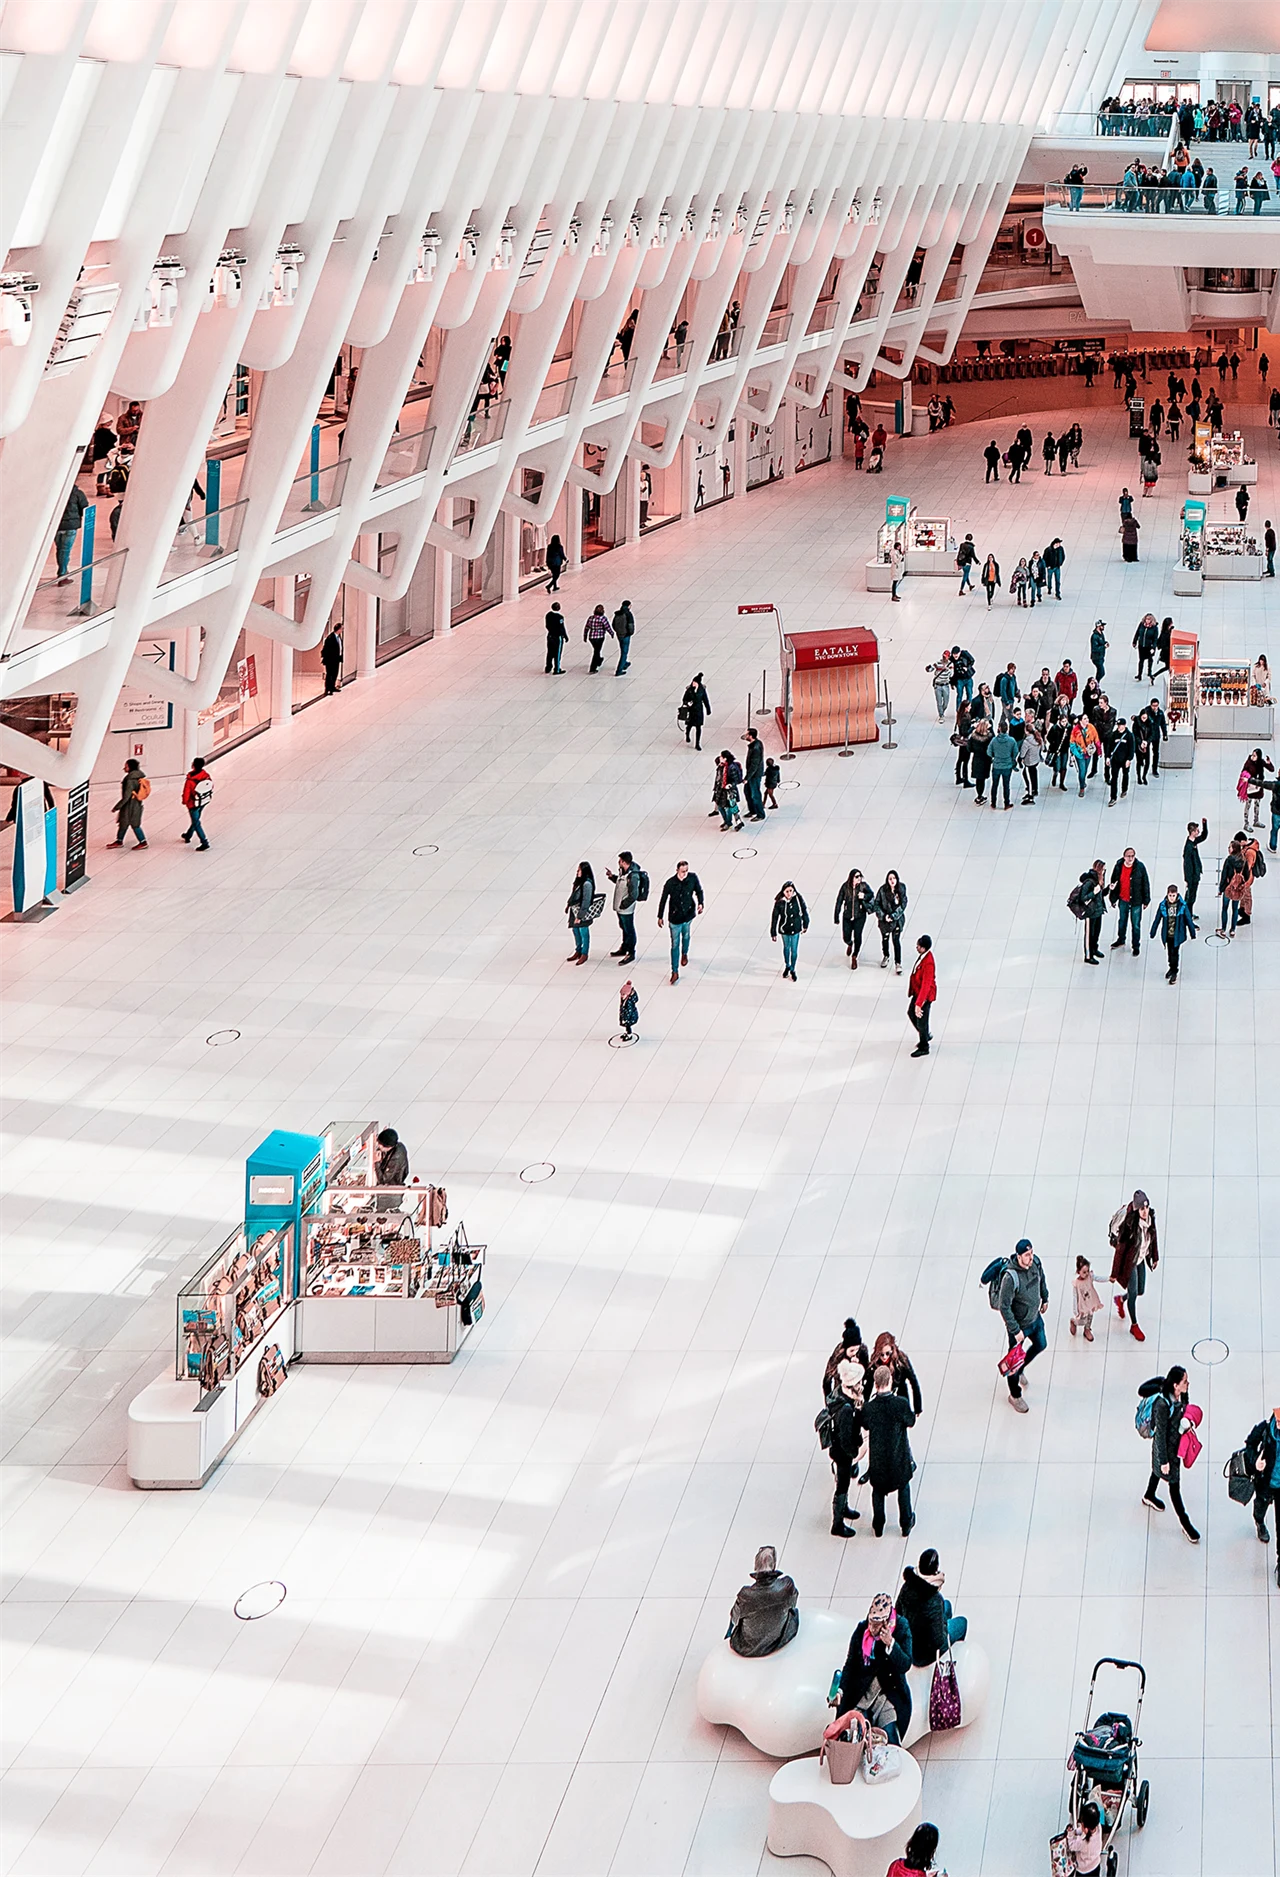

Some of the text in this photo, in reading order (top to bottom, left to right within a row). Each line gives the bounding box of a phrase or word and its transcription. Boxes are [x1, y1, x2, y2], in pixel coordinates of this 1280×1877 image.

[1031, 232, 1037, 242] 1
[1069, 311, 1087, 322] PA
[814, 645, 858, 656] EATALY
[827, 651, 858, 659] DOWNTOWN
